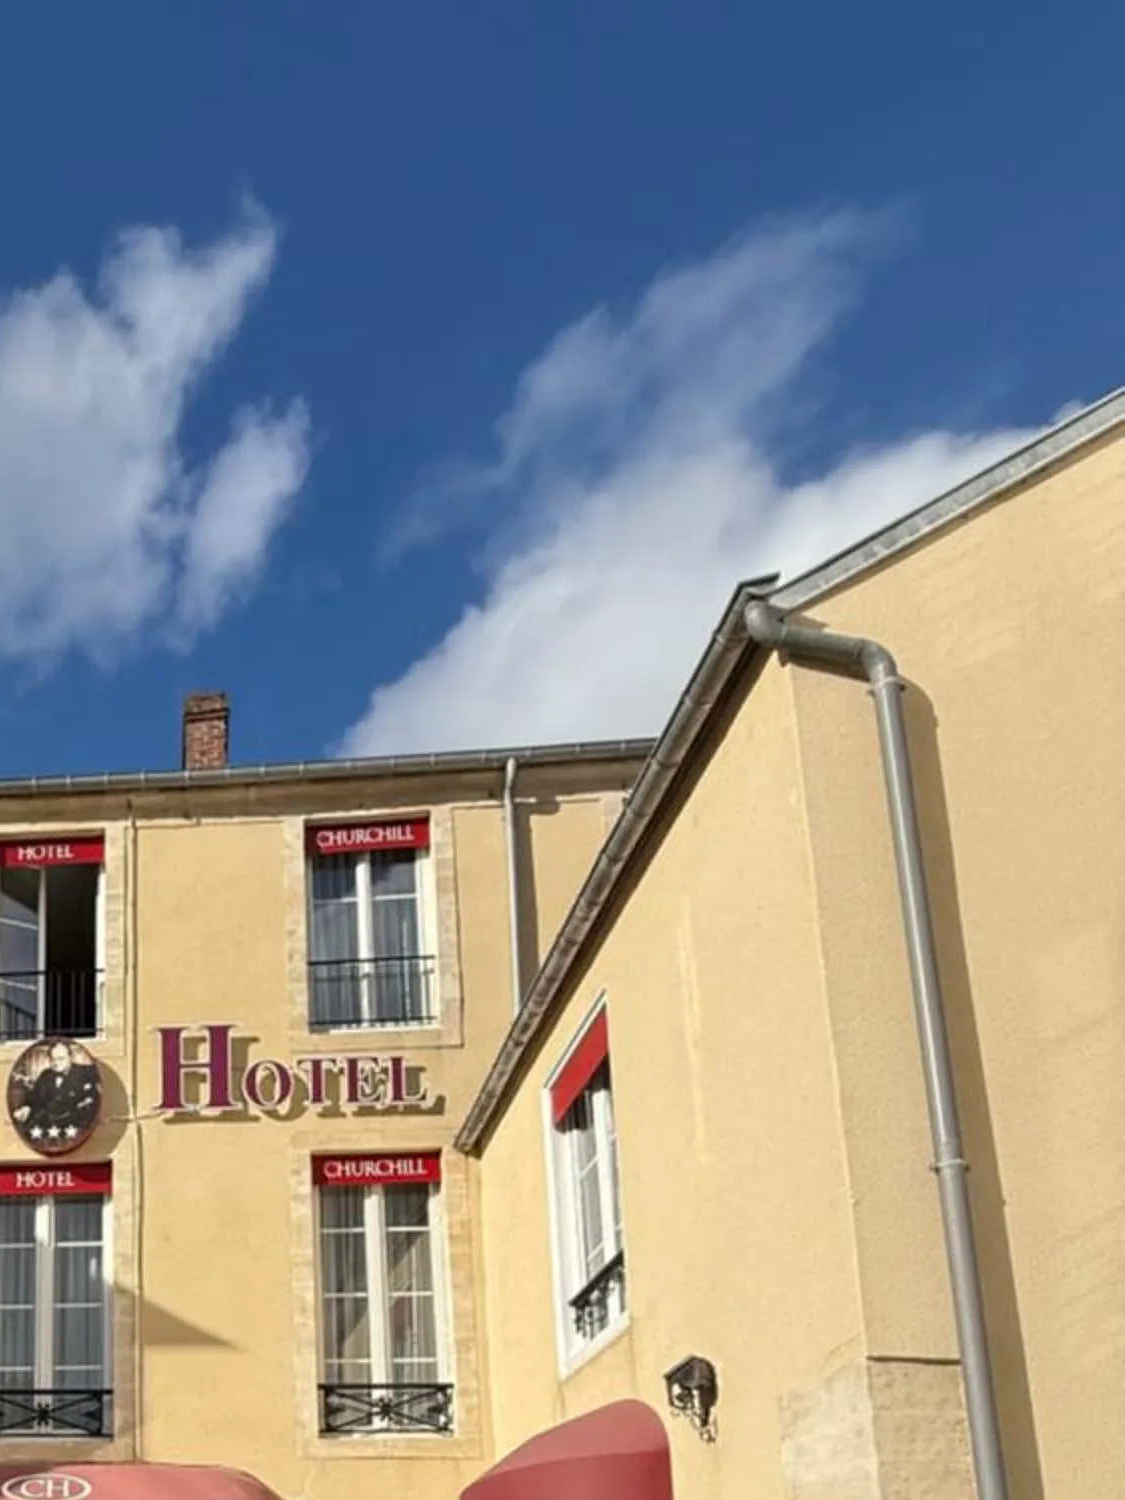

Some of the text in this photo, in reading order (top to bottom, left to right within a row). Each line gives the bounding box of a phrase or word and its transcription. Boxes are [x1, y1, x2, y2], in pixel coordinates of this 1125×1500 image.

[316, 824, 415, 847] CHURCHILL
[17, 844, 75, 860] HOTEL
[156, 1022, 430, 1111] HOTEL
[323, 1158, 428, 1178] CHURCHILL
[16, 1171, 75, 1188] HOTEL
[20, 1479, 70, 1498] CH
